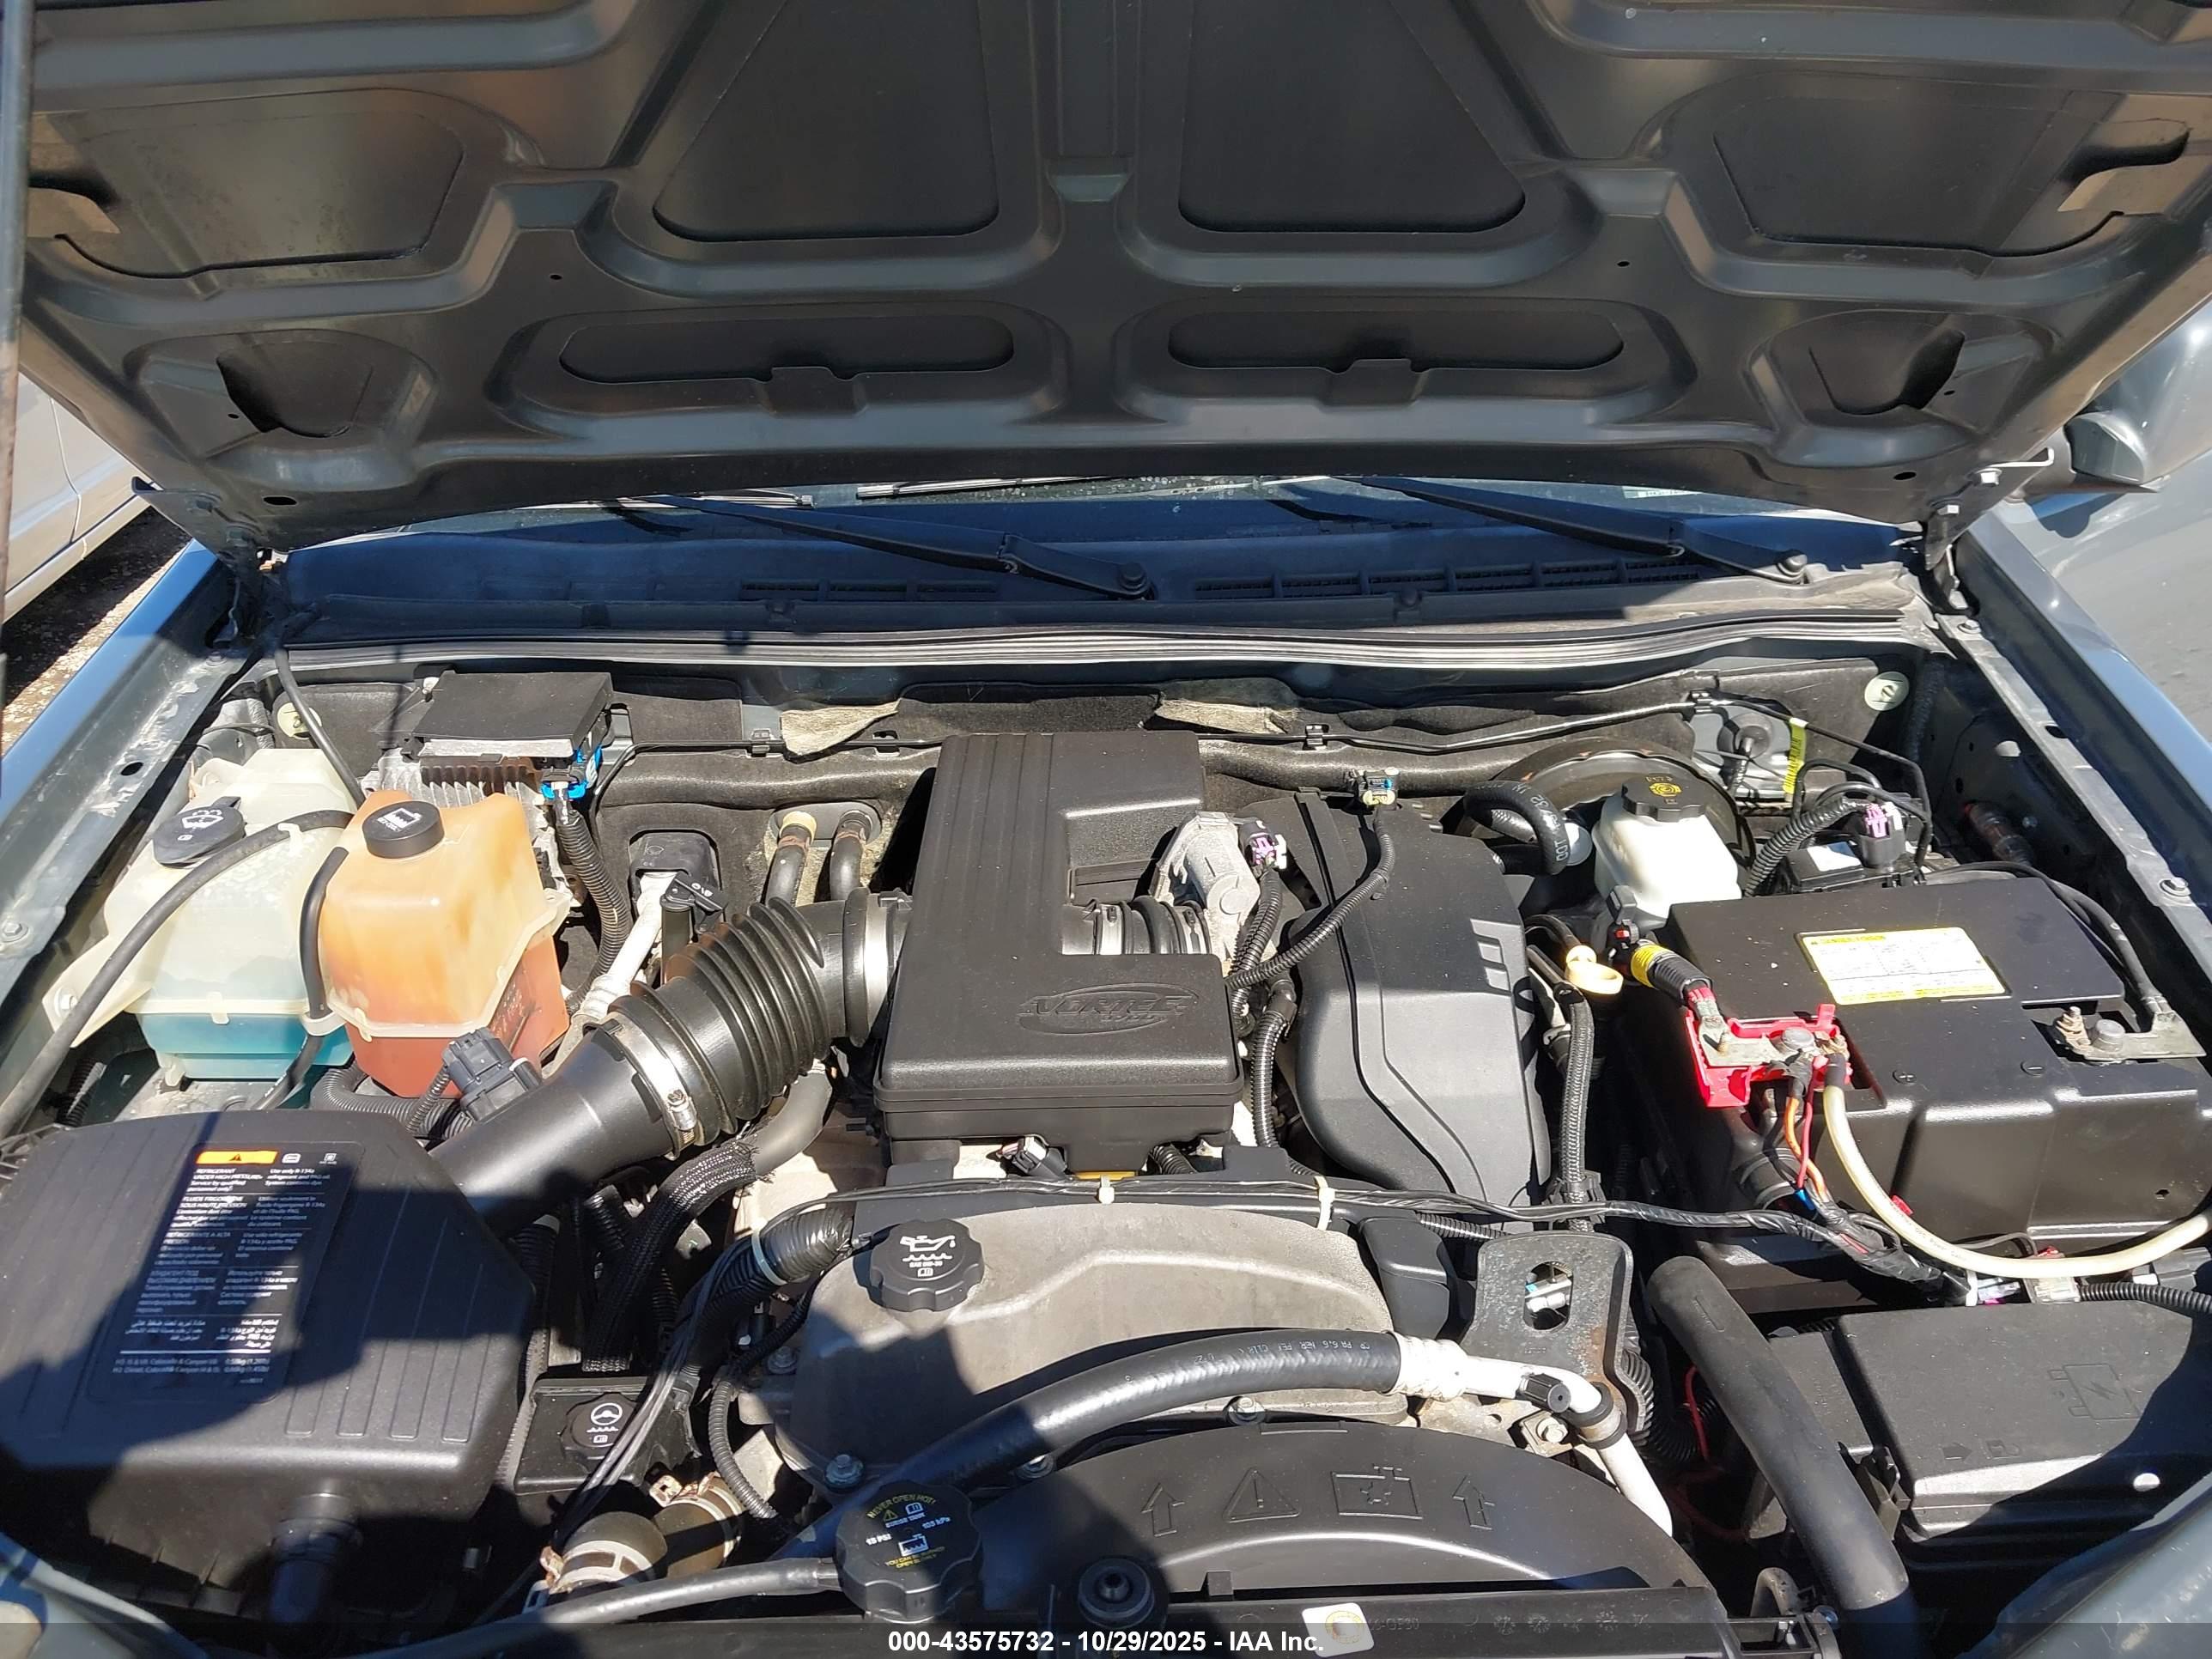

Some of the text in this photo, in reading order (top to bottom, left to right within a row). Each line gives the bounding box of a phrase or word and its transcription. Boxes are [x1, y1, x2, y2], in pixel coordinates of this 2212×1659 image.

[866, 1494, 937, 1518] NEVER OPEN HOT!
